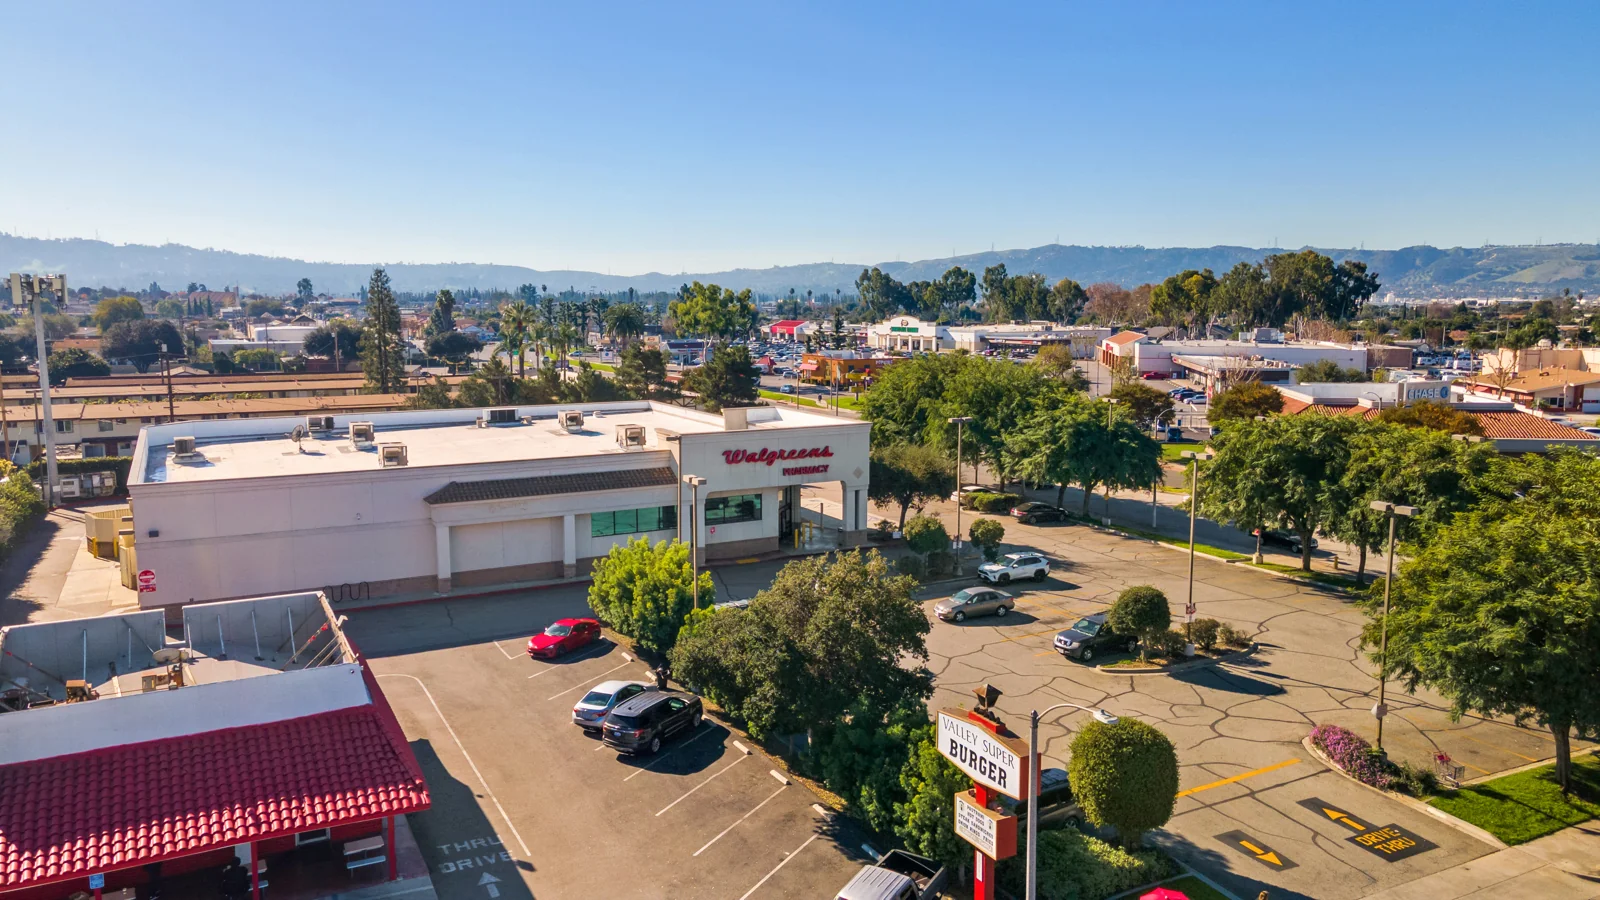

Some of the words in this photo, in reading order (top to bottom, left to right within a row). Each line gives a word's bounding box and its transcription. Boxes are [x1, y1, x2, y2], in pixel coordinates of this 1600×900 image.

[1408, 388, 1440, 399] CHASE
[722, 446, 834, 466] Walgreens
[782, 465, 829, 476] PHARMACY
[942, 716, 978, 746] VALLEY
[982, 740, 1014, 770] SUPER
[949, 738, 1007, 789] BURGER
[1355, 828, 1400, 846] DRIVE
[1374, 836, 1416, 854] THRU
[438, 850, 517, 874] DRIVE
